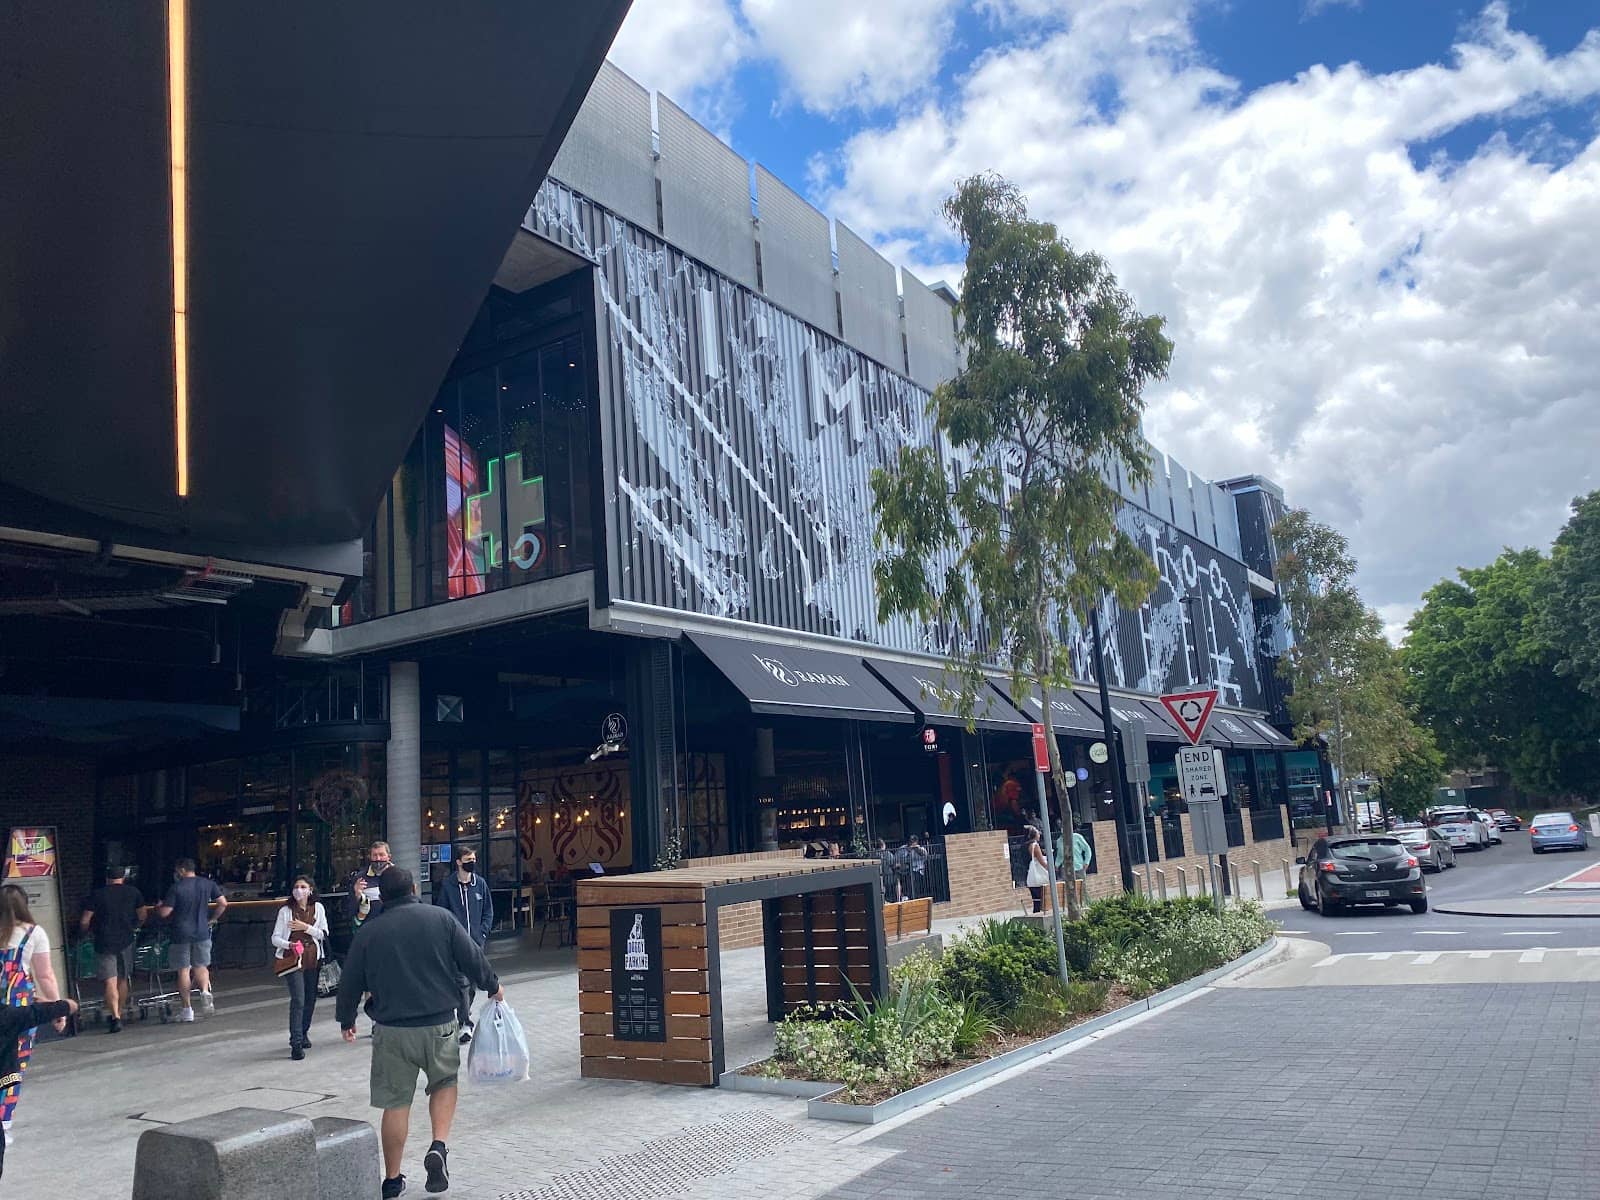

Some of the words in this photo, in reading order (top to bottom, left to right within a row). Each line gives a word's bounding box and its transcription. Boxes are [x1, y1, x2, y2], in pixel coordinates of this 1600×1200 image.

[794, 670, 850, 687] RAMAN
[1184, 752, 1209, 762] END
[625, 955, 648, 968] PARKING
